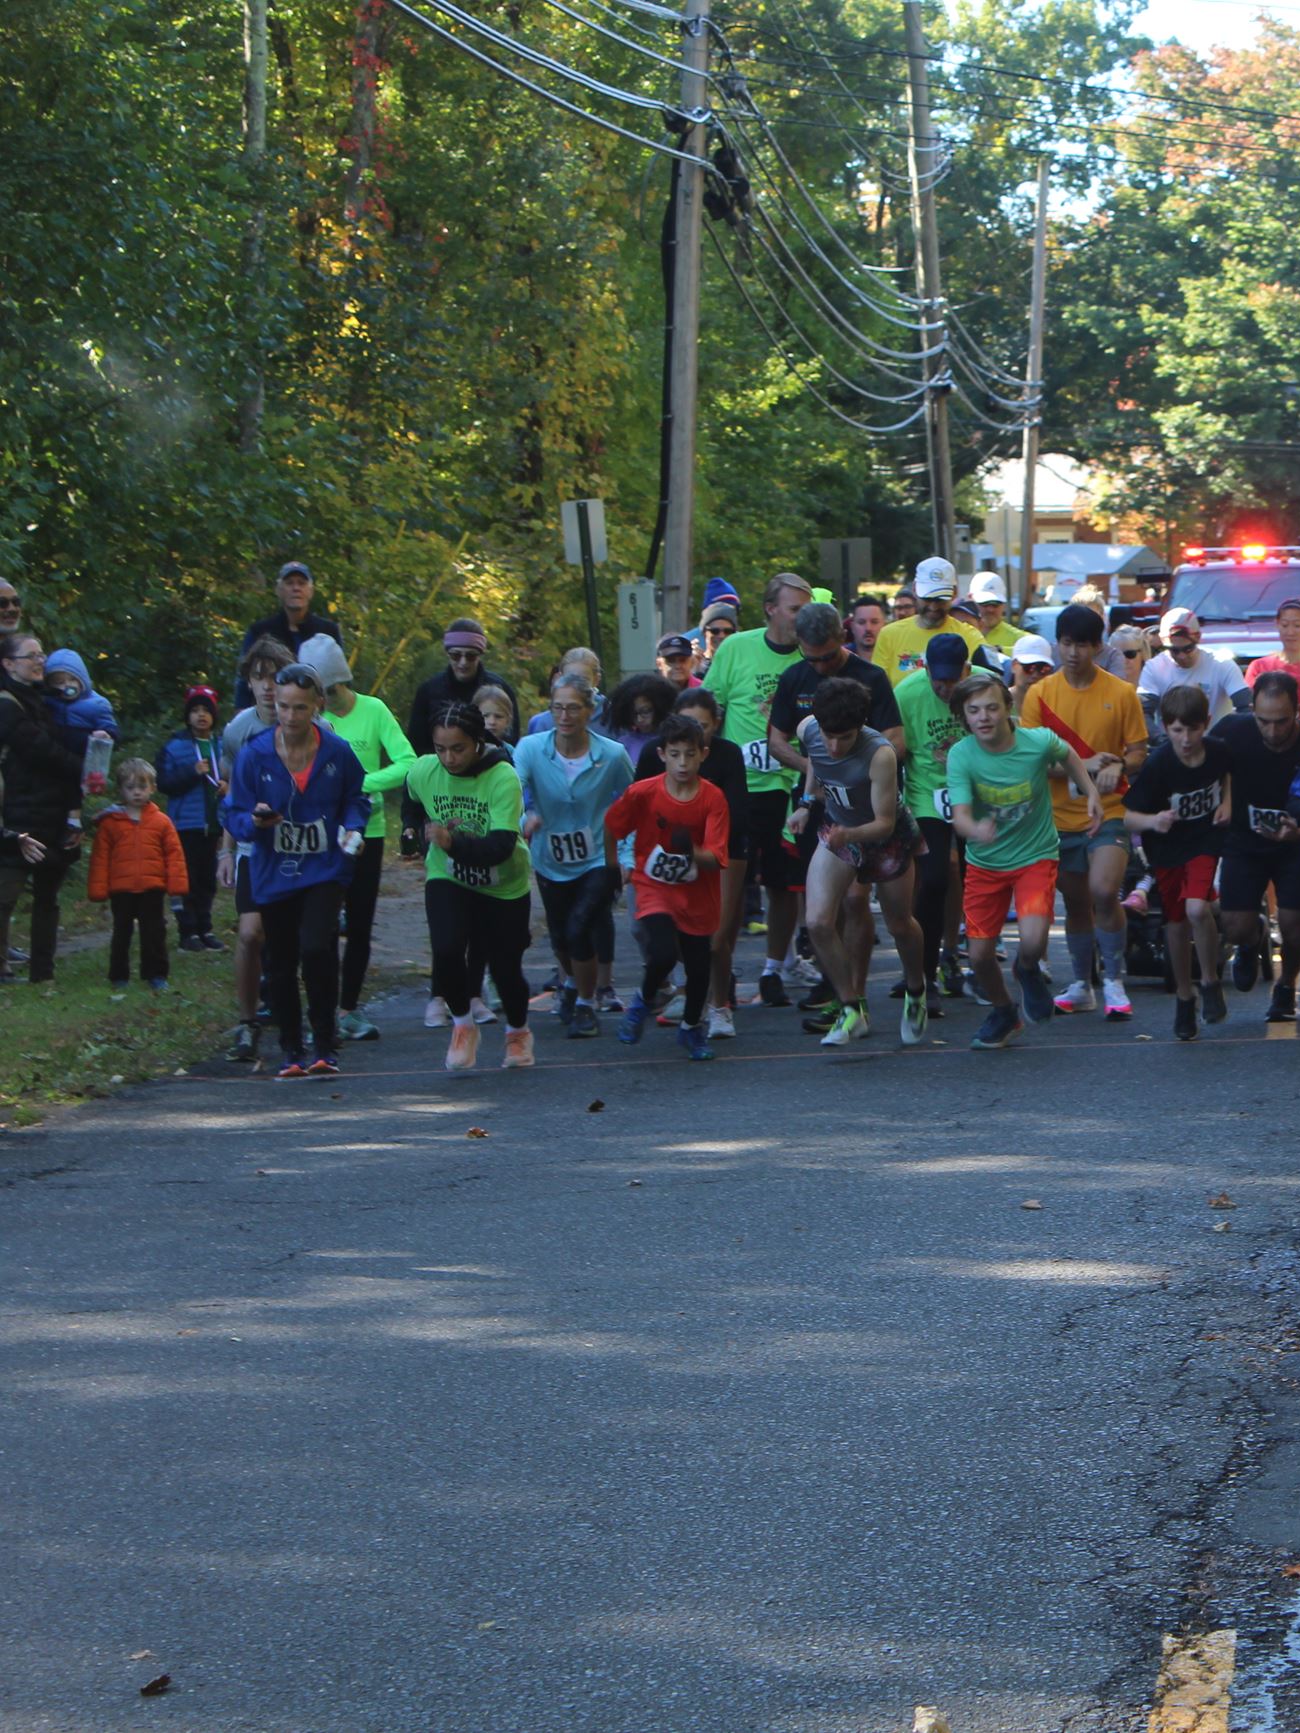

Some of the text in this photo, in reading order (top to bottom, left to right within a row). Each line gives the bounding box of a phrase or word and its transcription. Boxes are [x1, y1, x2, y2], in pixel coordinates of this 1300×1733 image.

[629, 592, 639, 630] 615
[749, 739, 770, 770] 87
[280, 821, 321, 852] 870
[551, 831, 588, 863] 819
[651, 851, 693, 883] 832
